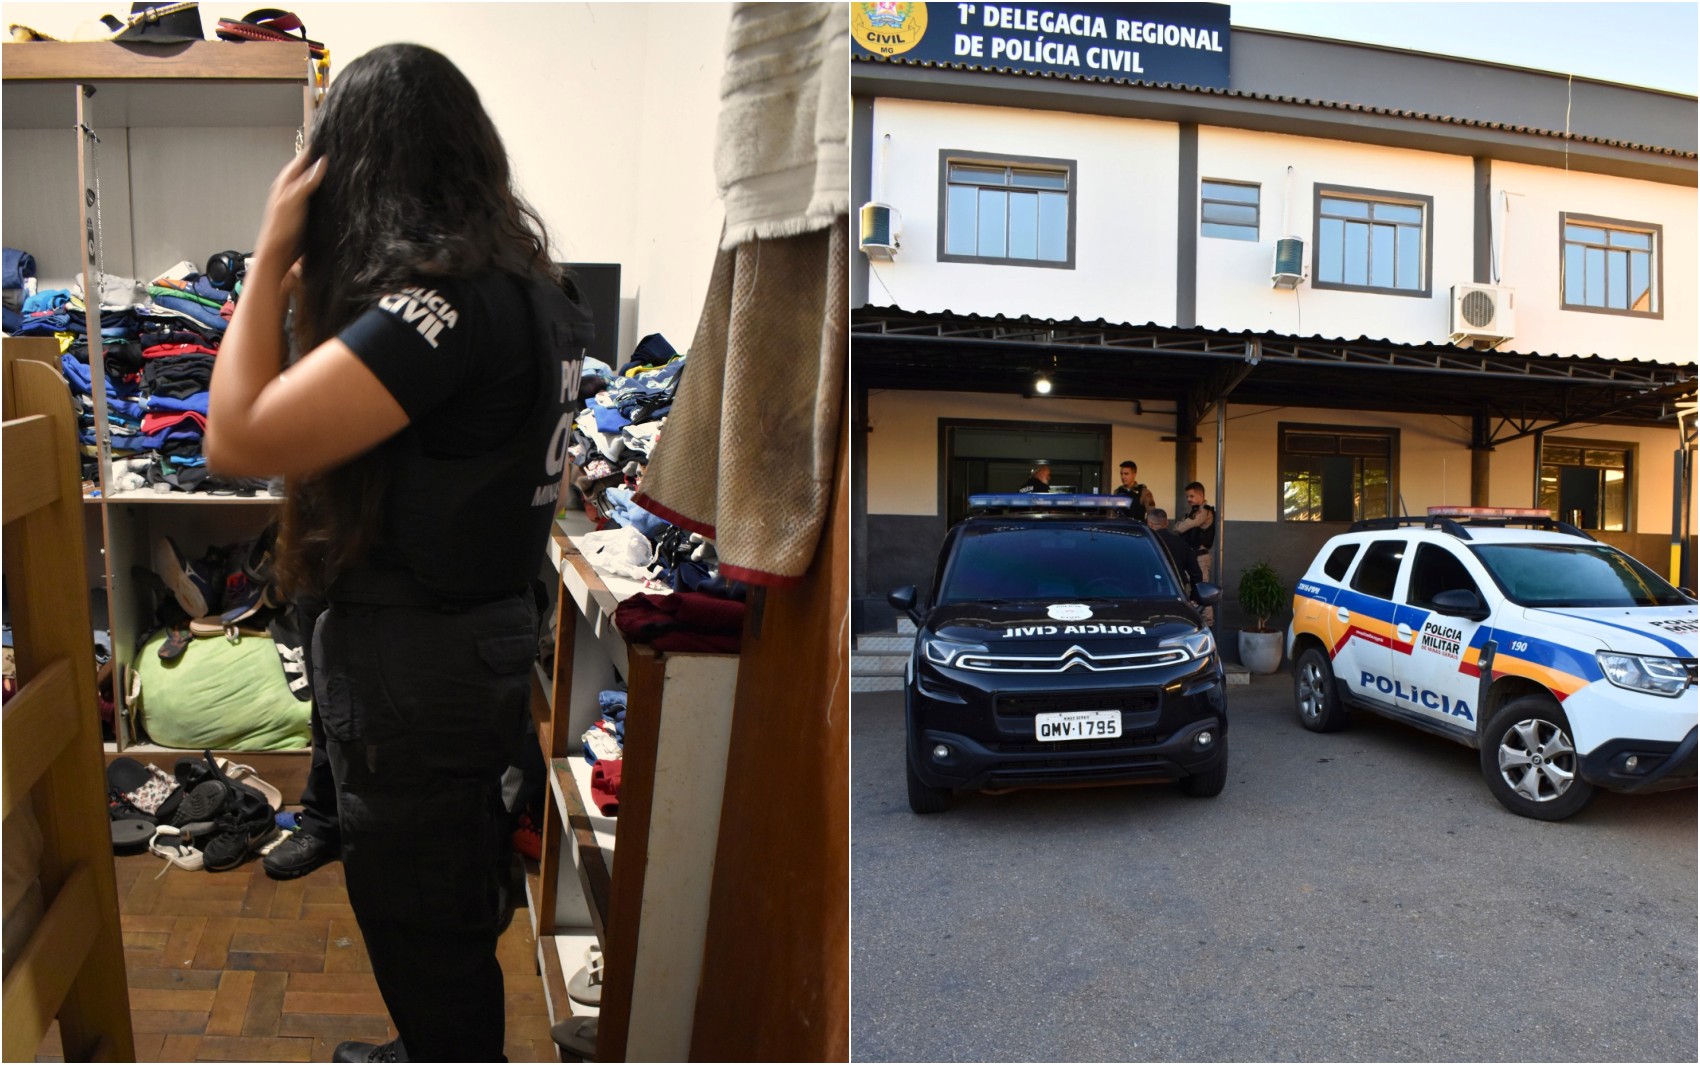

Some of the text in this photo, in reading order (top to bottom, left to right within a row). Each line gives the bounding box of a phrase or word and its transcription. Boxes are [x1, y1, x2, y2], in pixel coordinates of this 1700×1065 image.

[866, 32, 906, 44] CIVIL
[983, 5, 1108, 38] DELEGACIA
[1116, 19, 1223, 52] REGIONAL
[954, 33, 1144, 74] DE POLÍCIA CIVIL
[378, 293, 445, 349] CIVIL
[1421, 635, 1460, 655] MILITAR
[1511, 641, 1528, 652] 190
